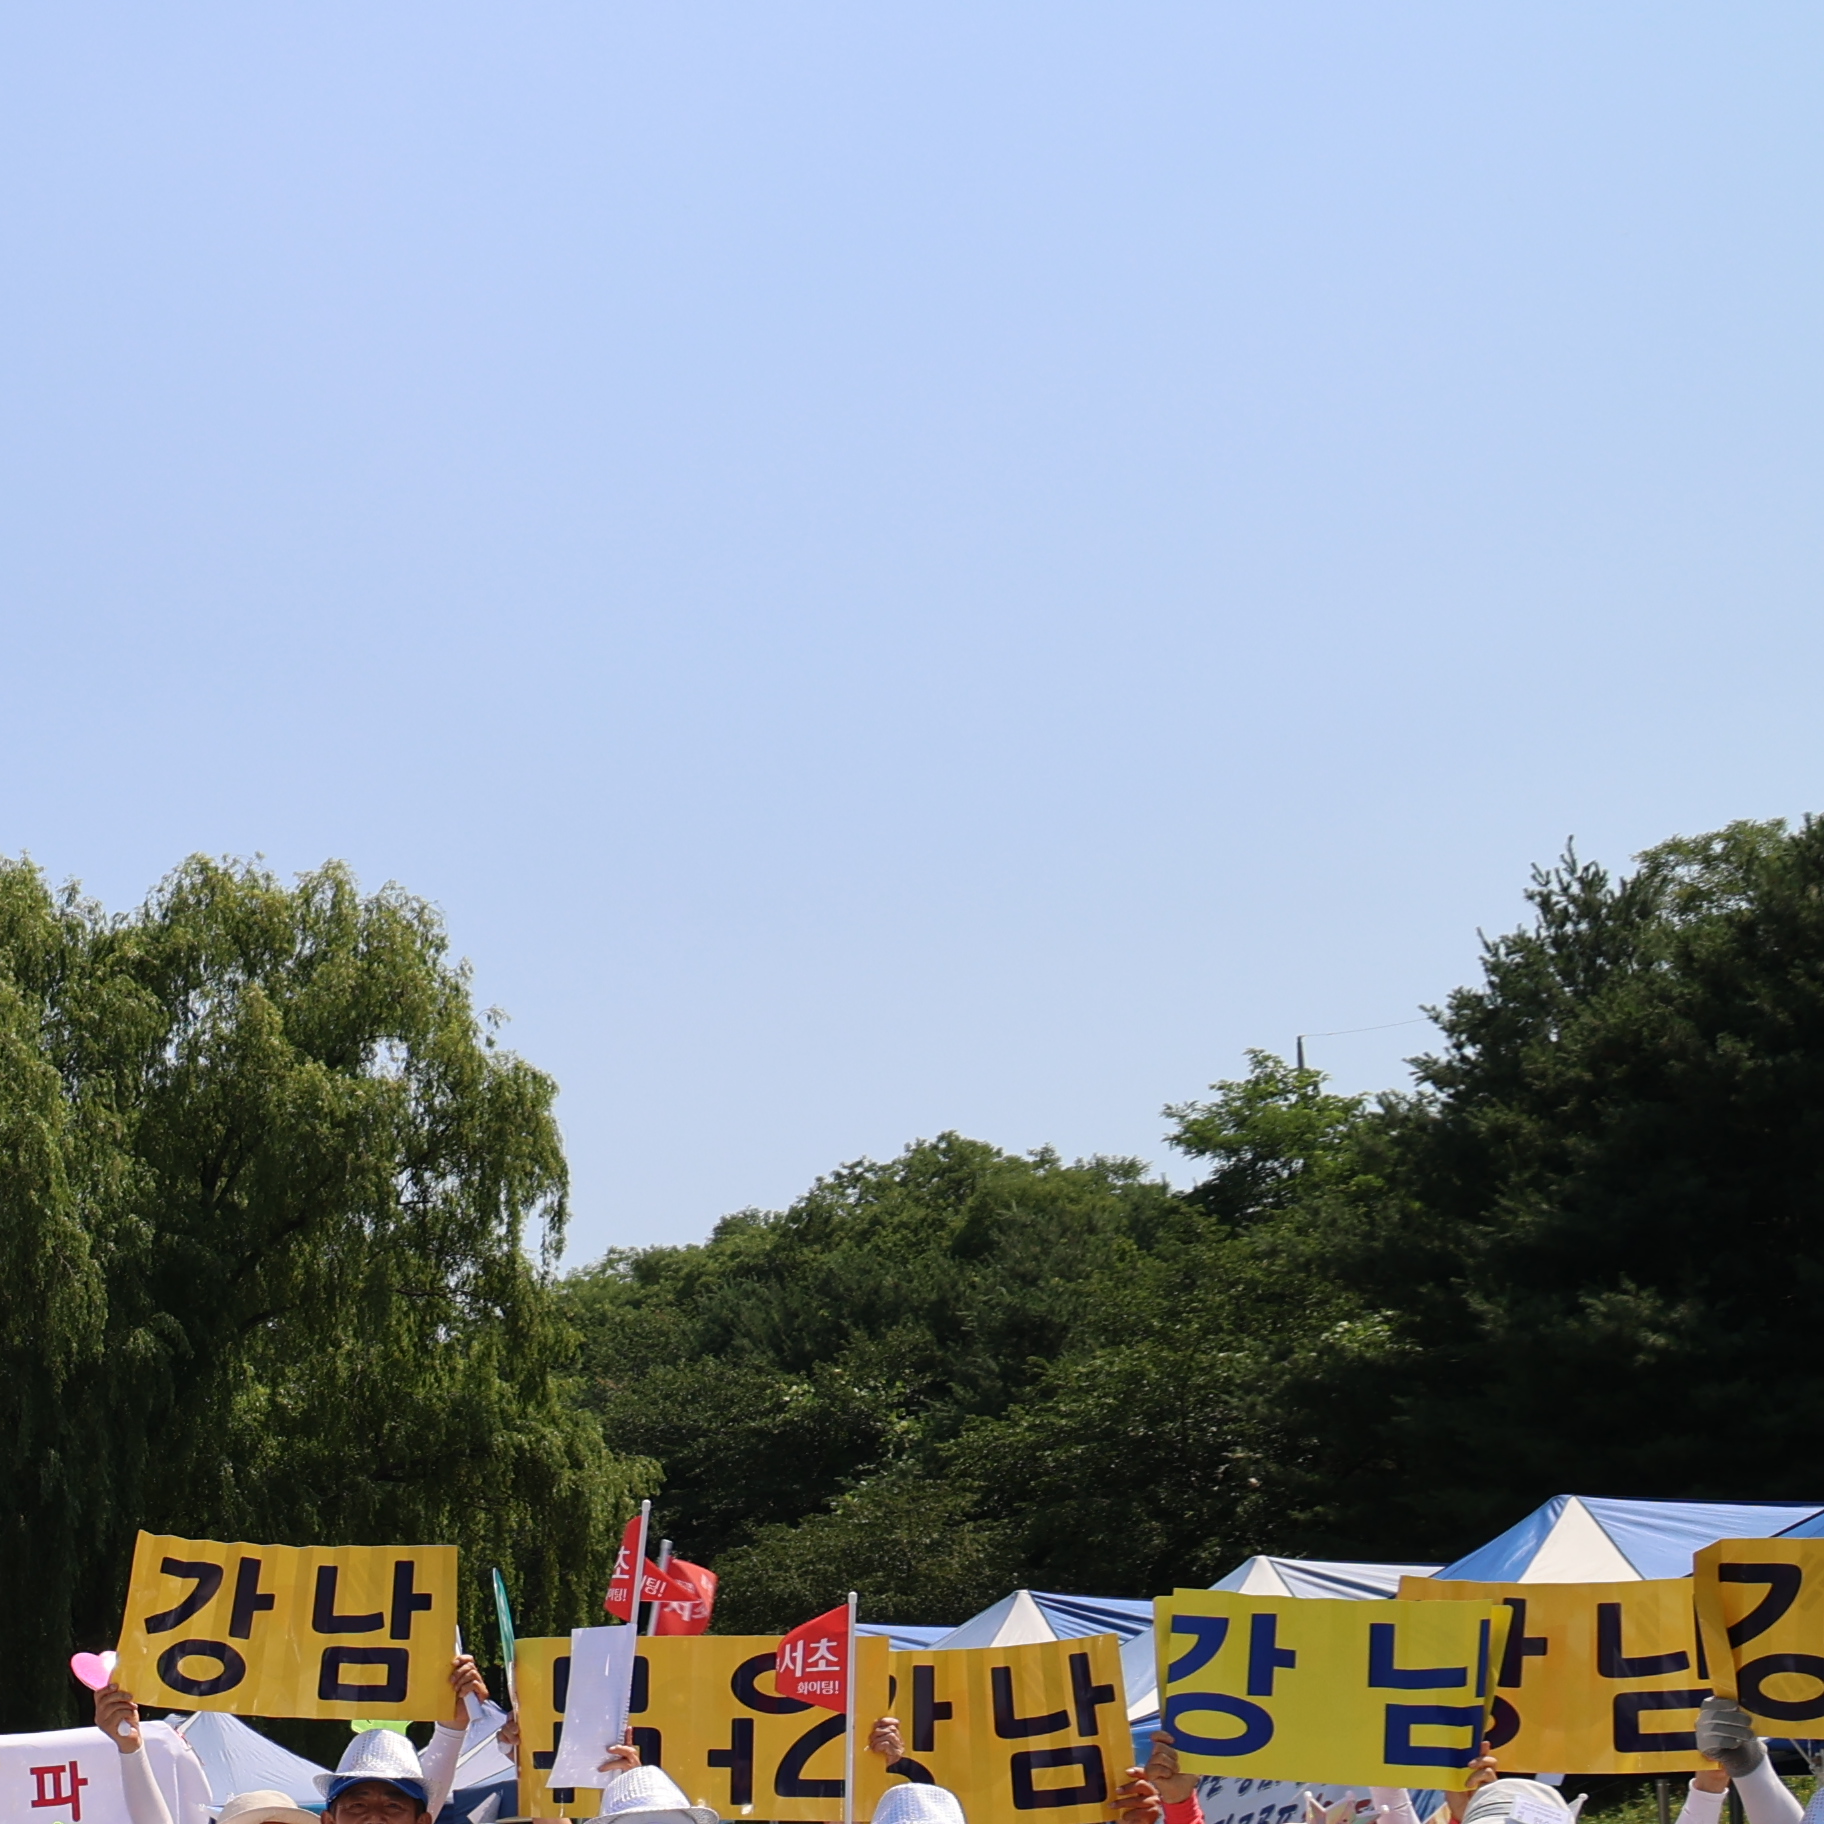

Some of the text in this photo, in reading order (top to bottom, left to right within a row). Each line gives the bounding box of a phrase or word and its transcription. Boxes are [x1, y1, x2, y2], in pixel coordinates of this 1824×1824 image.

[640, 1575, 667, 1598] 팅!
[144, 1556, 432, 1704] 강남
[779, 1637, 841, 1677] 서초
[796, 1680, 840, 1695] 화이팅!
[1167, 1613, 1490, 1769] 강남
[30, 1761, 88, 1822] 파
